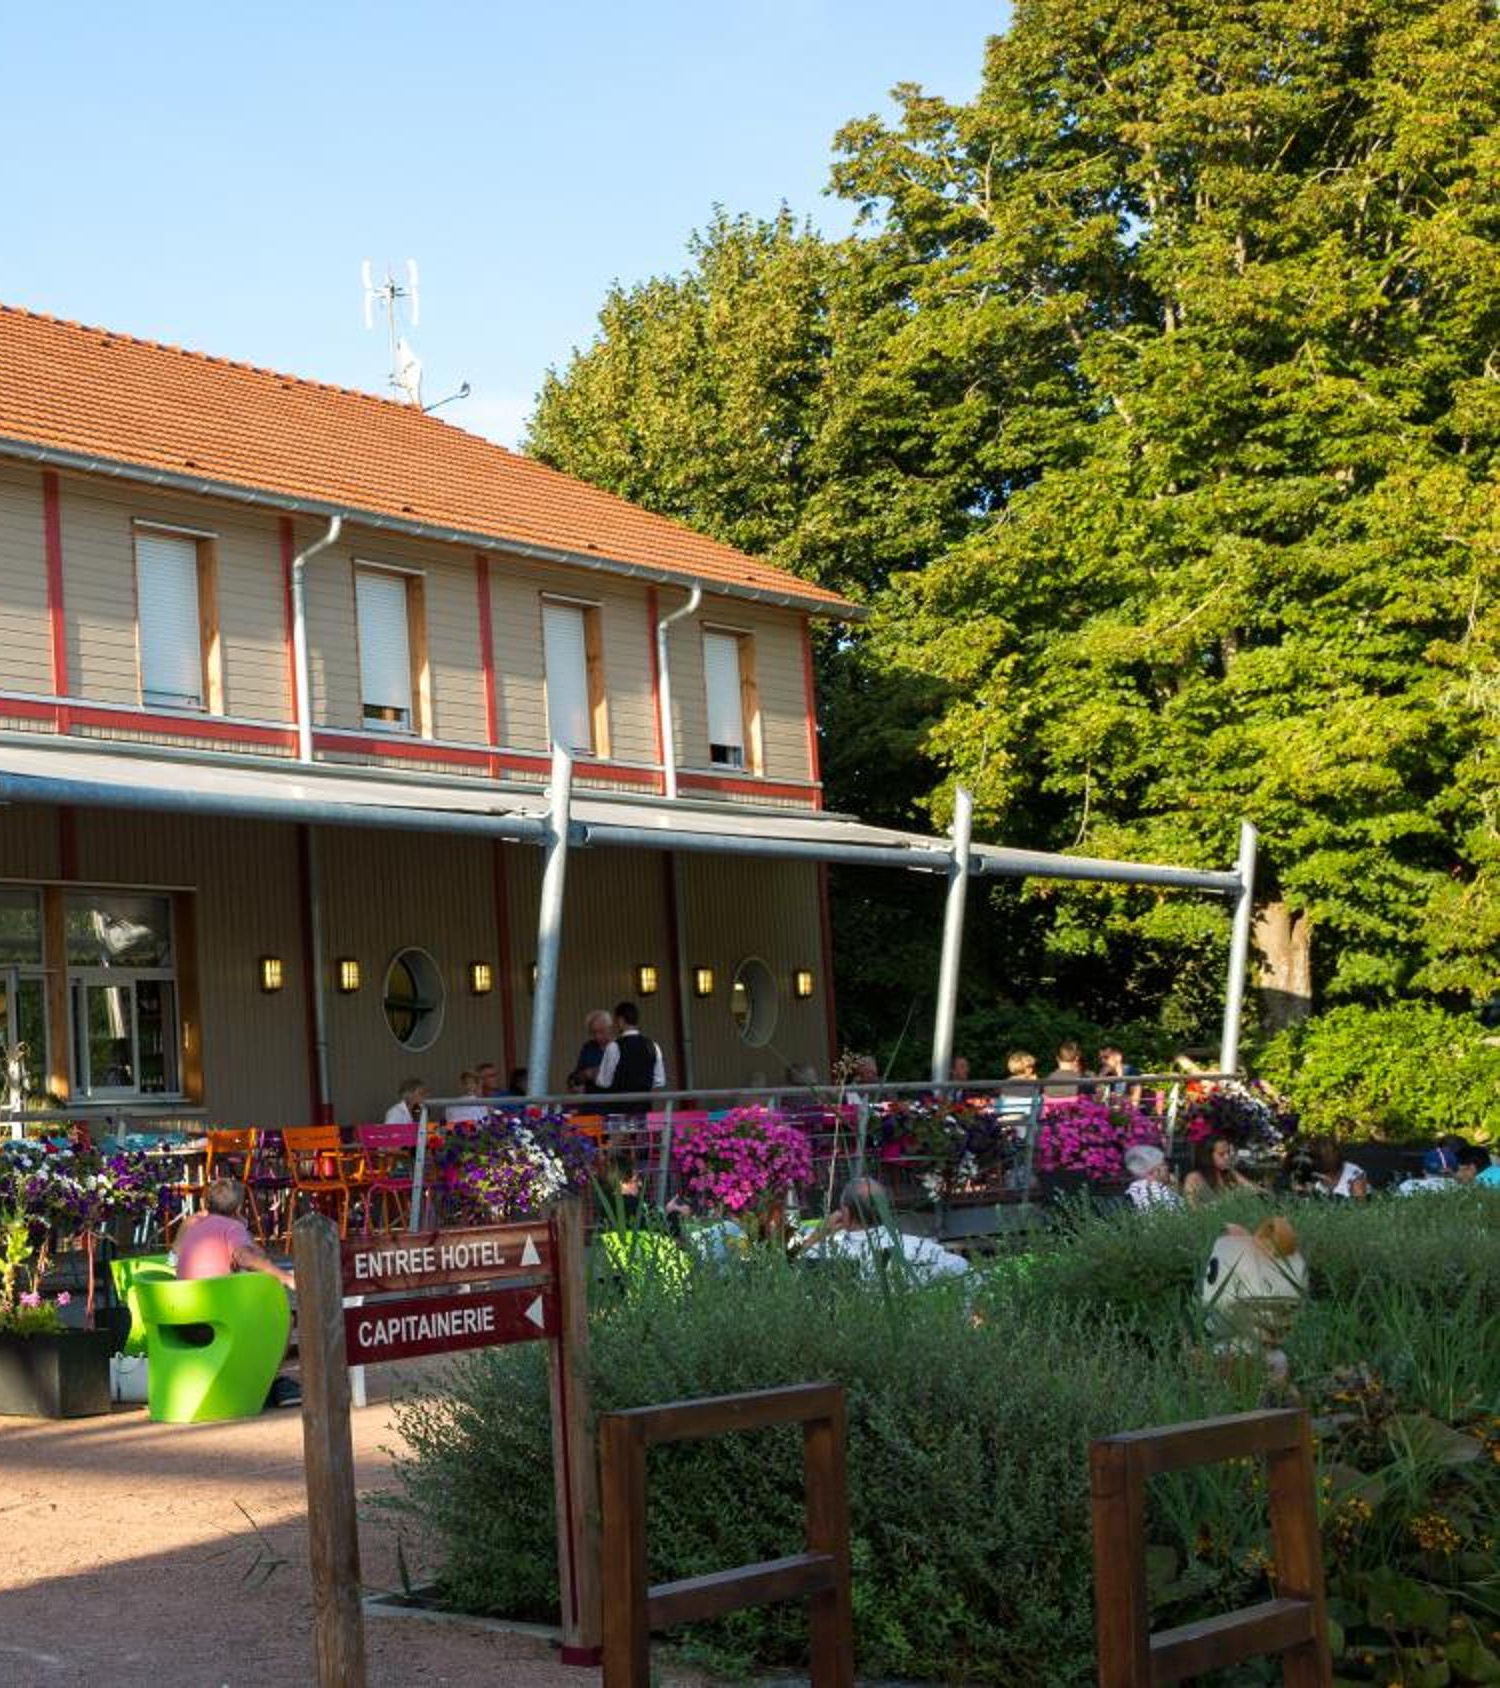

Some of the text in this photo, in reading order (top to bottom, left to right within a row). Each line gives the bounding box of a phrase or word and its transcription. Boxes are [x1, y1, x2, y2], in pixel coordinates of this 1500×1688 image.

[355, 1241, 505, 1279] ENTREE HOTEL
[359, 1306, 495, 1347] CAPITAINERIE
